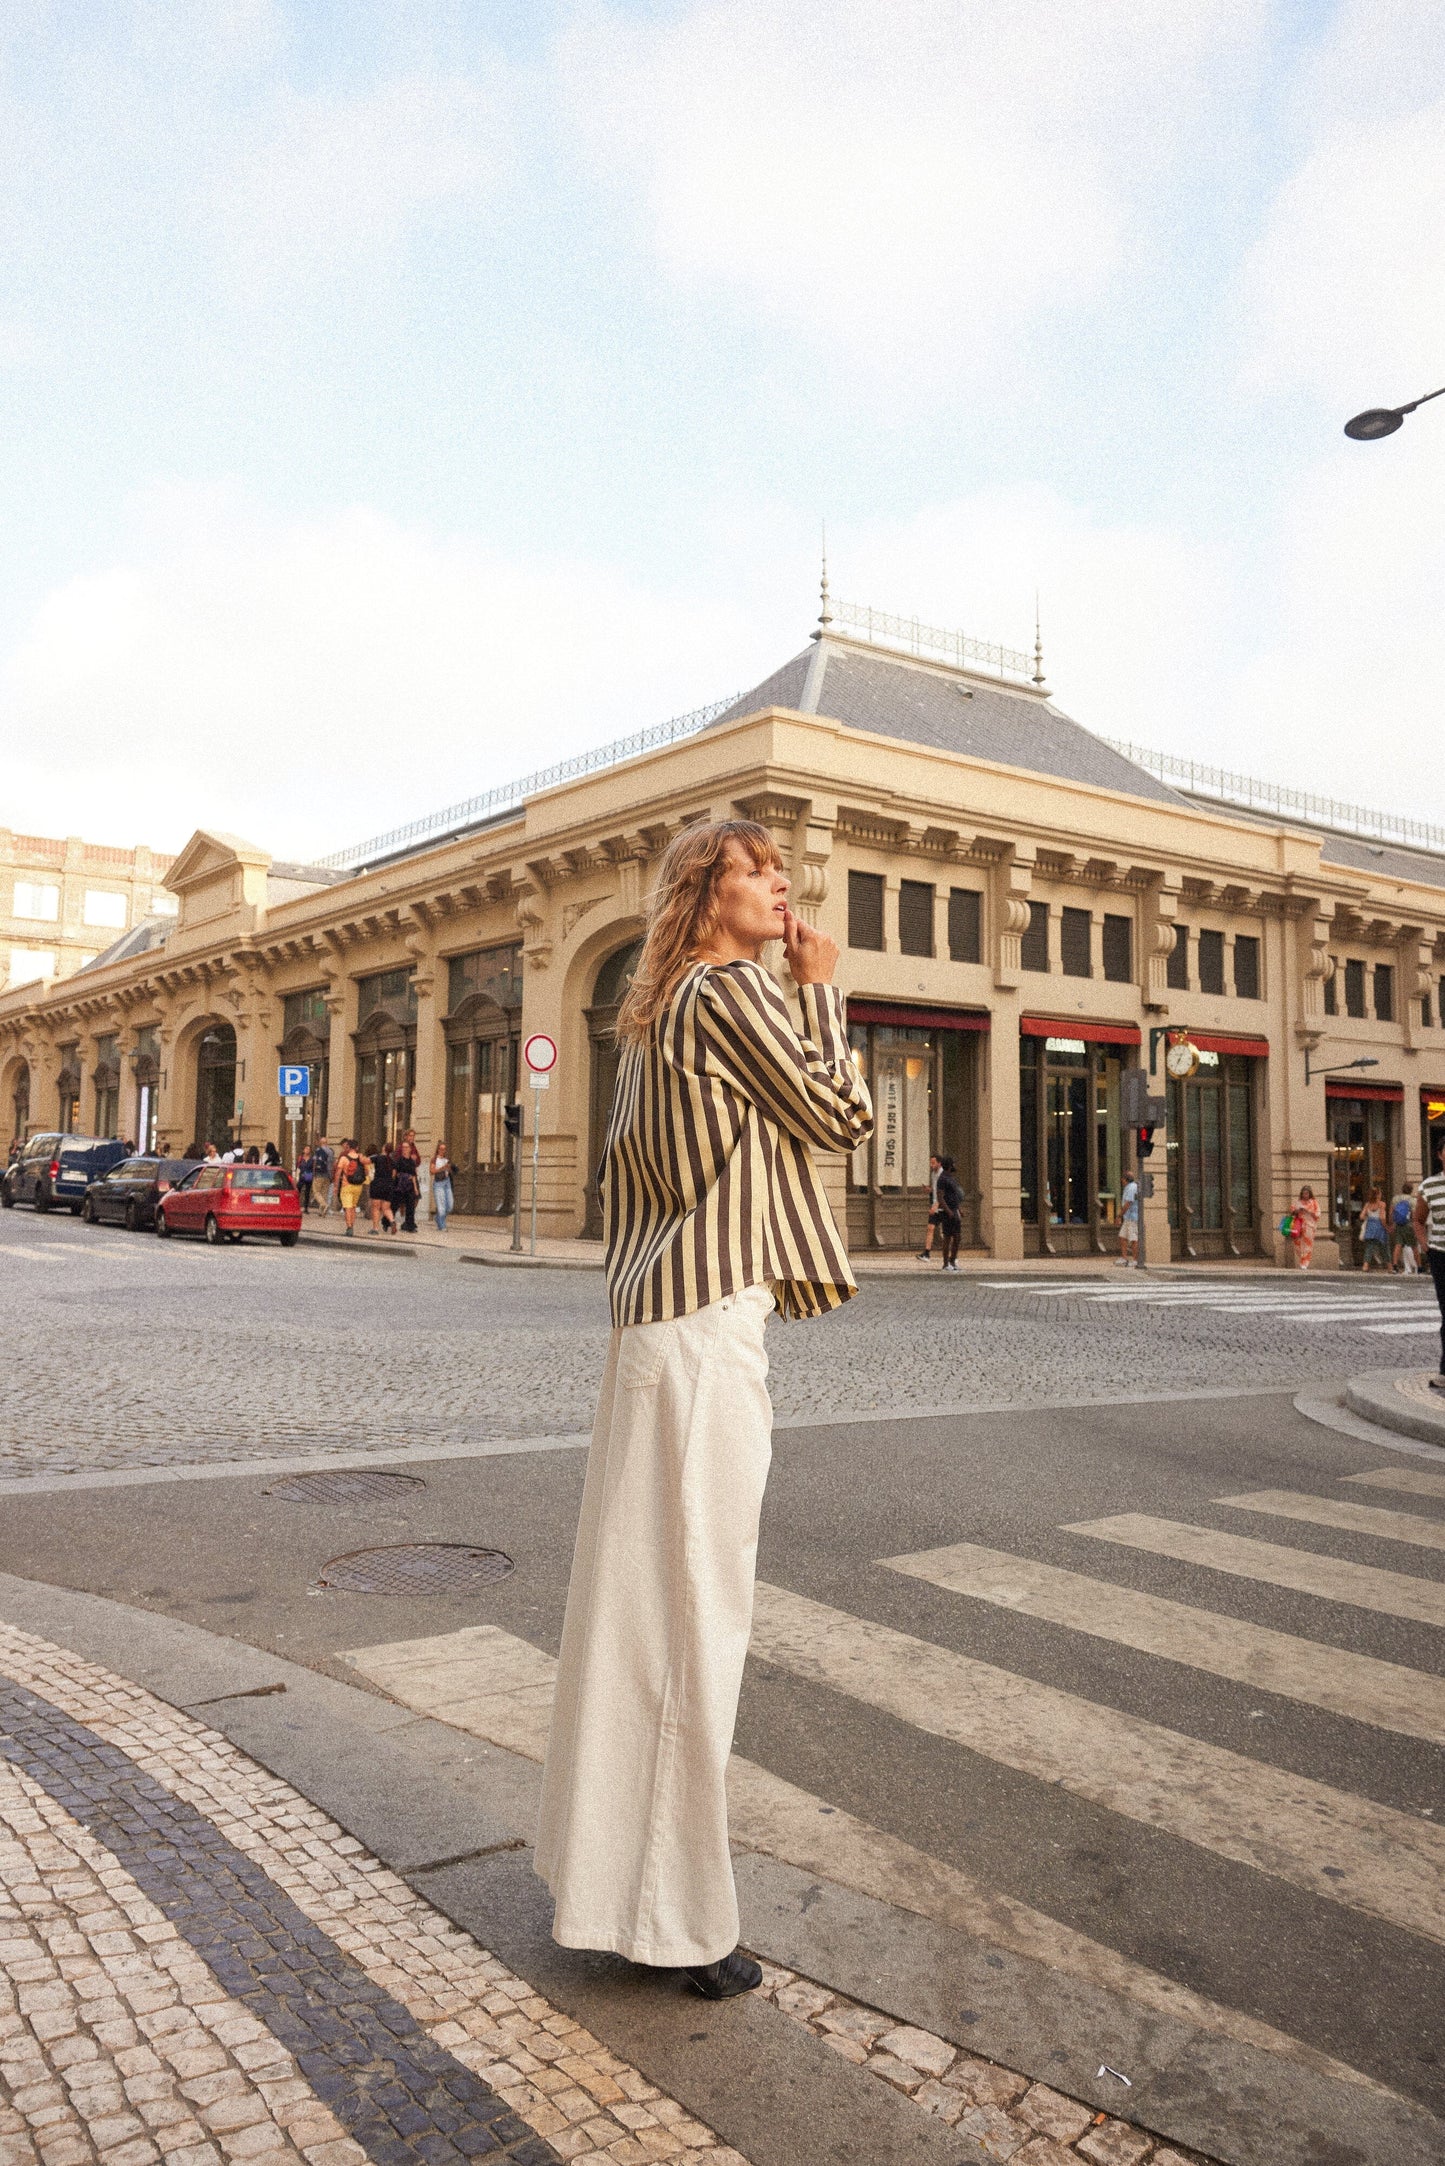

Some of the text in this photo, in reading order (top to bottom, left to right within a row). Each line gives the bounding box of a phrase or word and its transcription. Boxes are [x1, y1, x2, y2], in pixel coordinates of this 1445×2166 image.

[285, 1068, 303, 1094] P
[887, 1084, 896, 1101] NOT
[884, 1139, 896, 1168] SPACE
